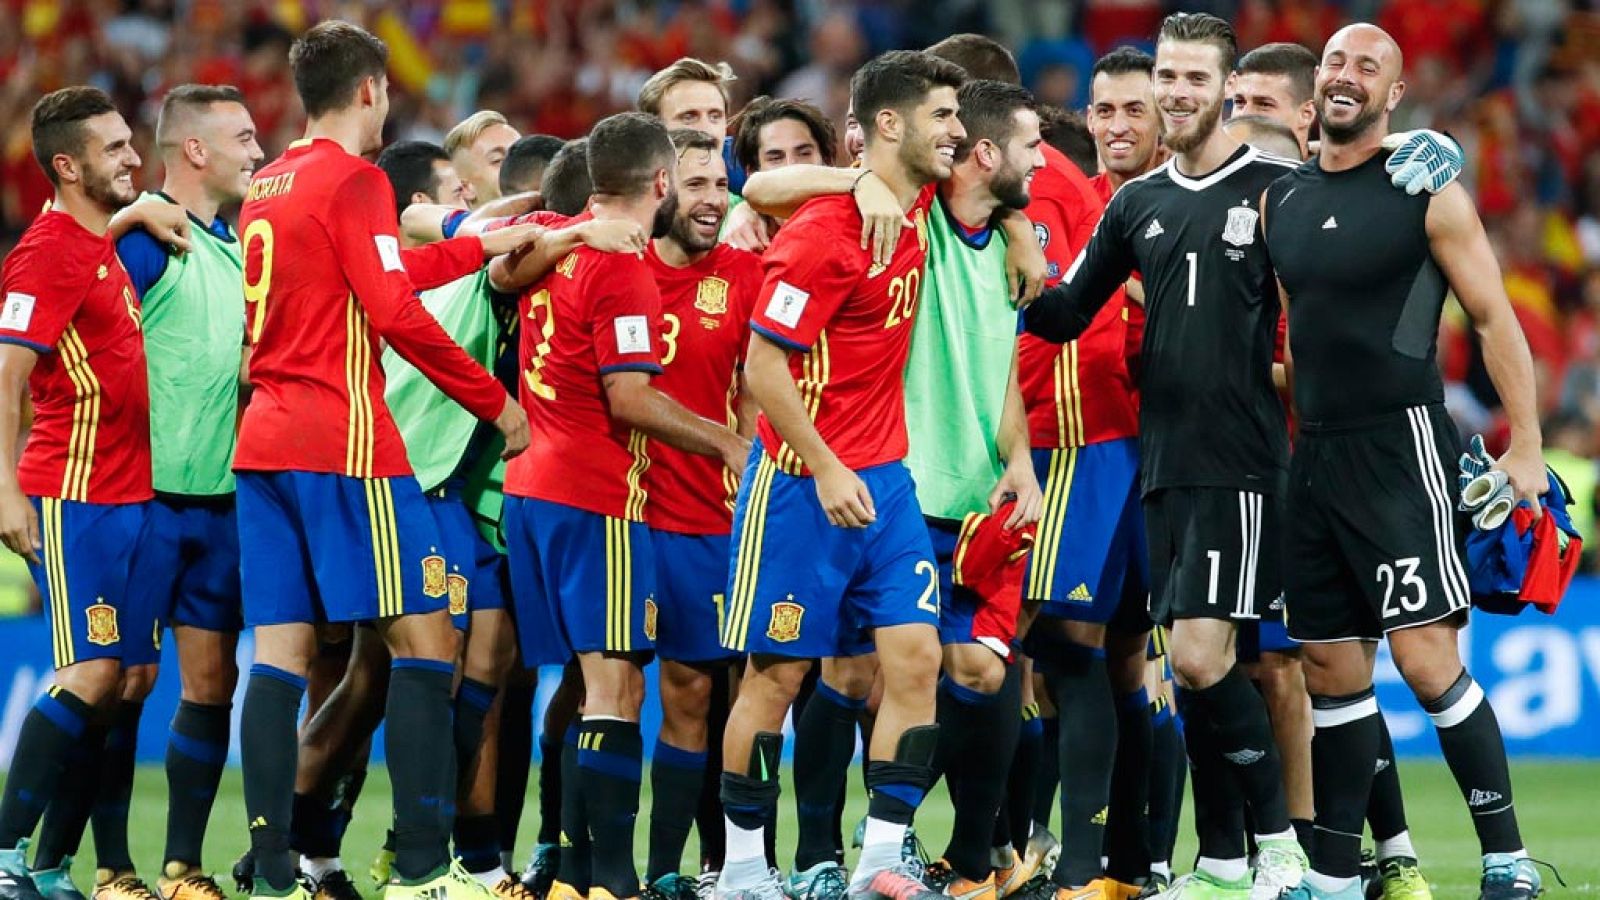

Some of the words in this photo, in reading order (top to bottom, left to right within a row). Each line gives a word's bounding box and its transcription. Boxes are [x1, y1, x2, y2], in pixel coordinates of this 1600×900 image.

[243, 219, 274, 343] 9
[884, 267, 920, 329] 20
[1186, 252, 1198, 306] 1
[524, 288, 557, 400] 2
[1206, 549, 1221, 604] 1
[1376, 557, 1429, 618] 23
